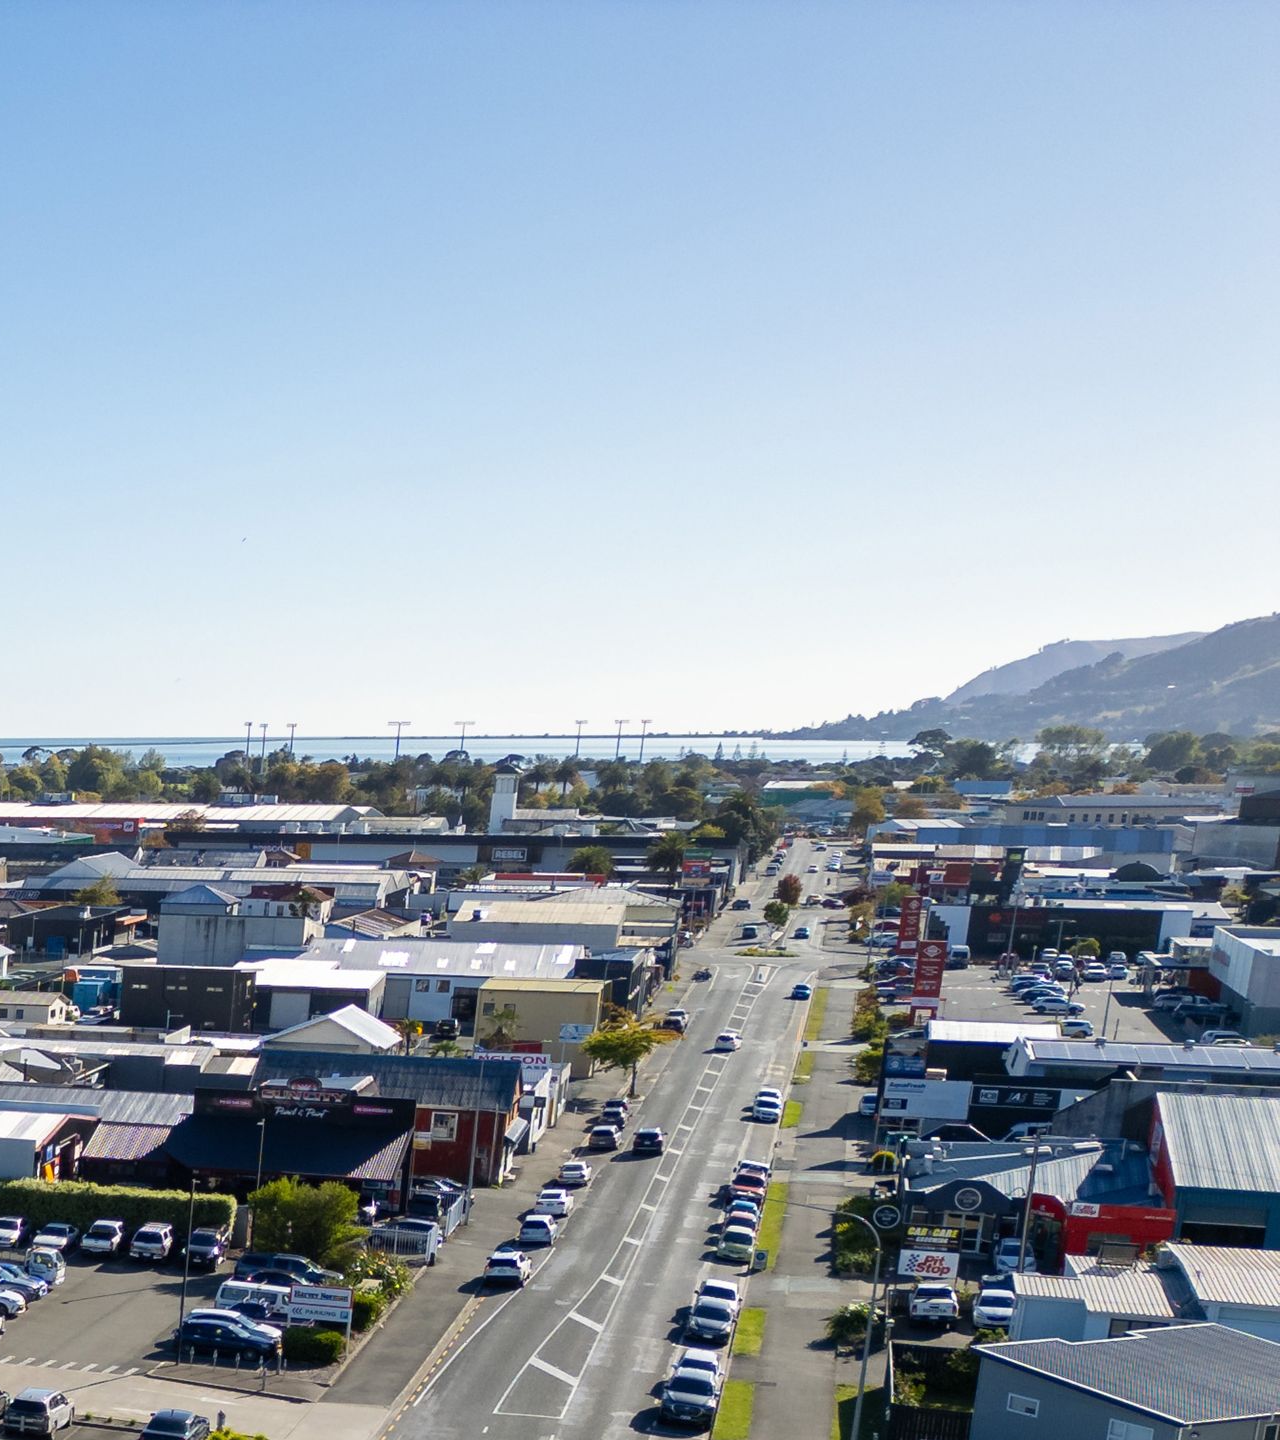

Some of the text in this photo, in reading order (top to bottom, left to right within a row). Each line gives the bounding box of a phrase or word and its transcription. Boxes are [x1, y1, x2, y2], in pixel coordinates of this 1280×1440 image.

[494, 850, 524, 860] REBEL
[924, 1255, 946, 1267] Pit
[914, 1262, 951, 1277] Stop
[304, 1309, 337, 1318] PARKING
